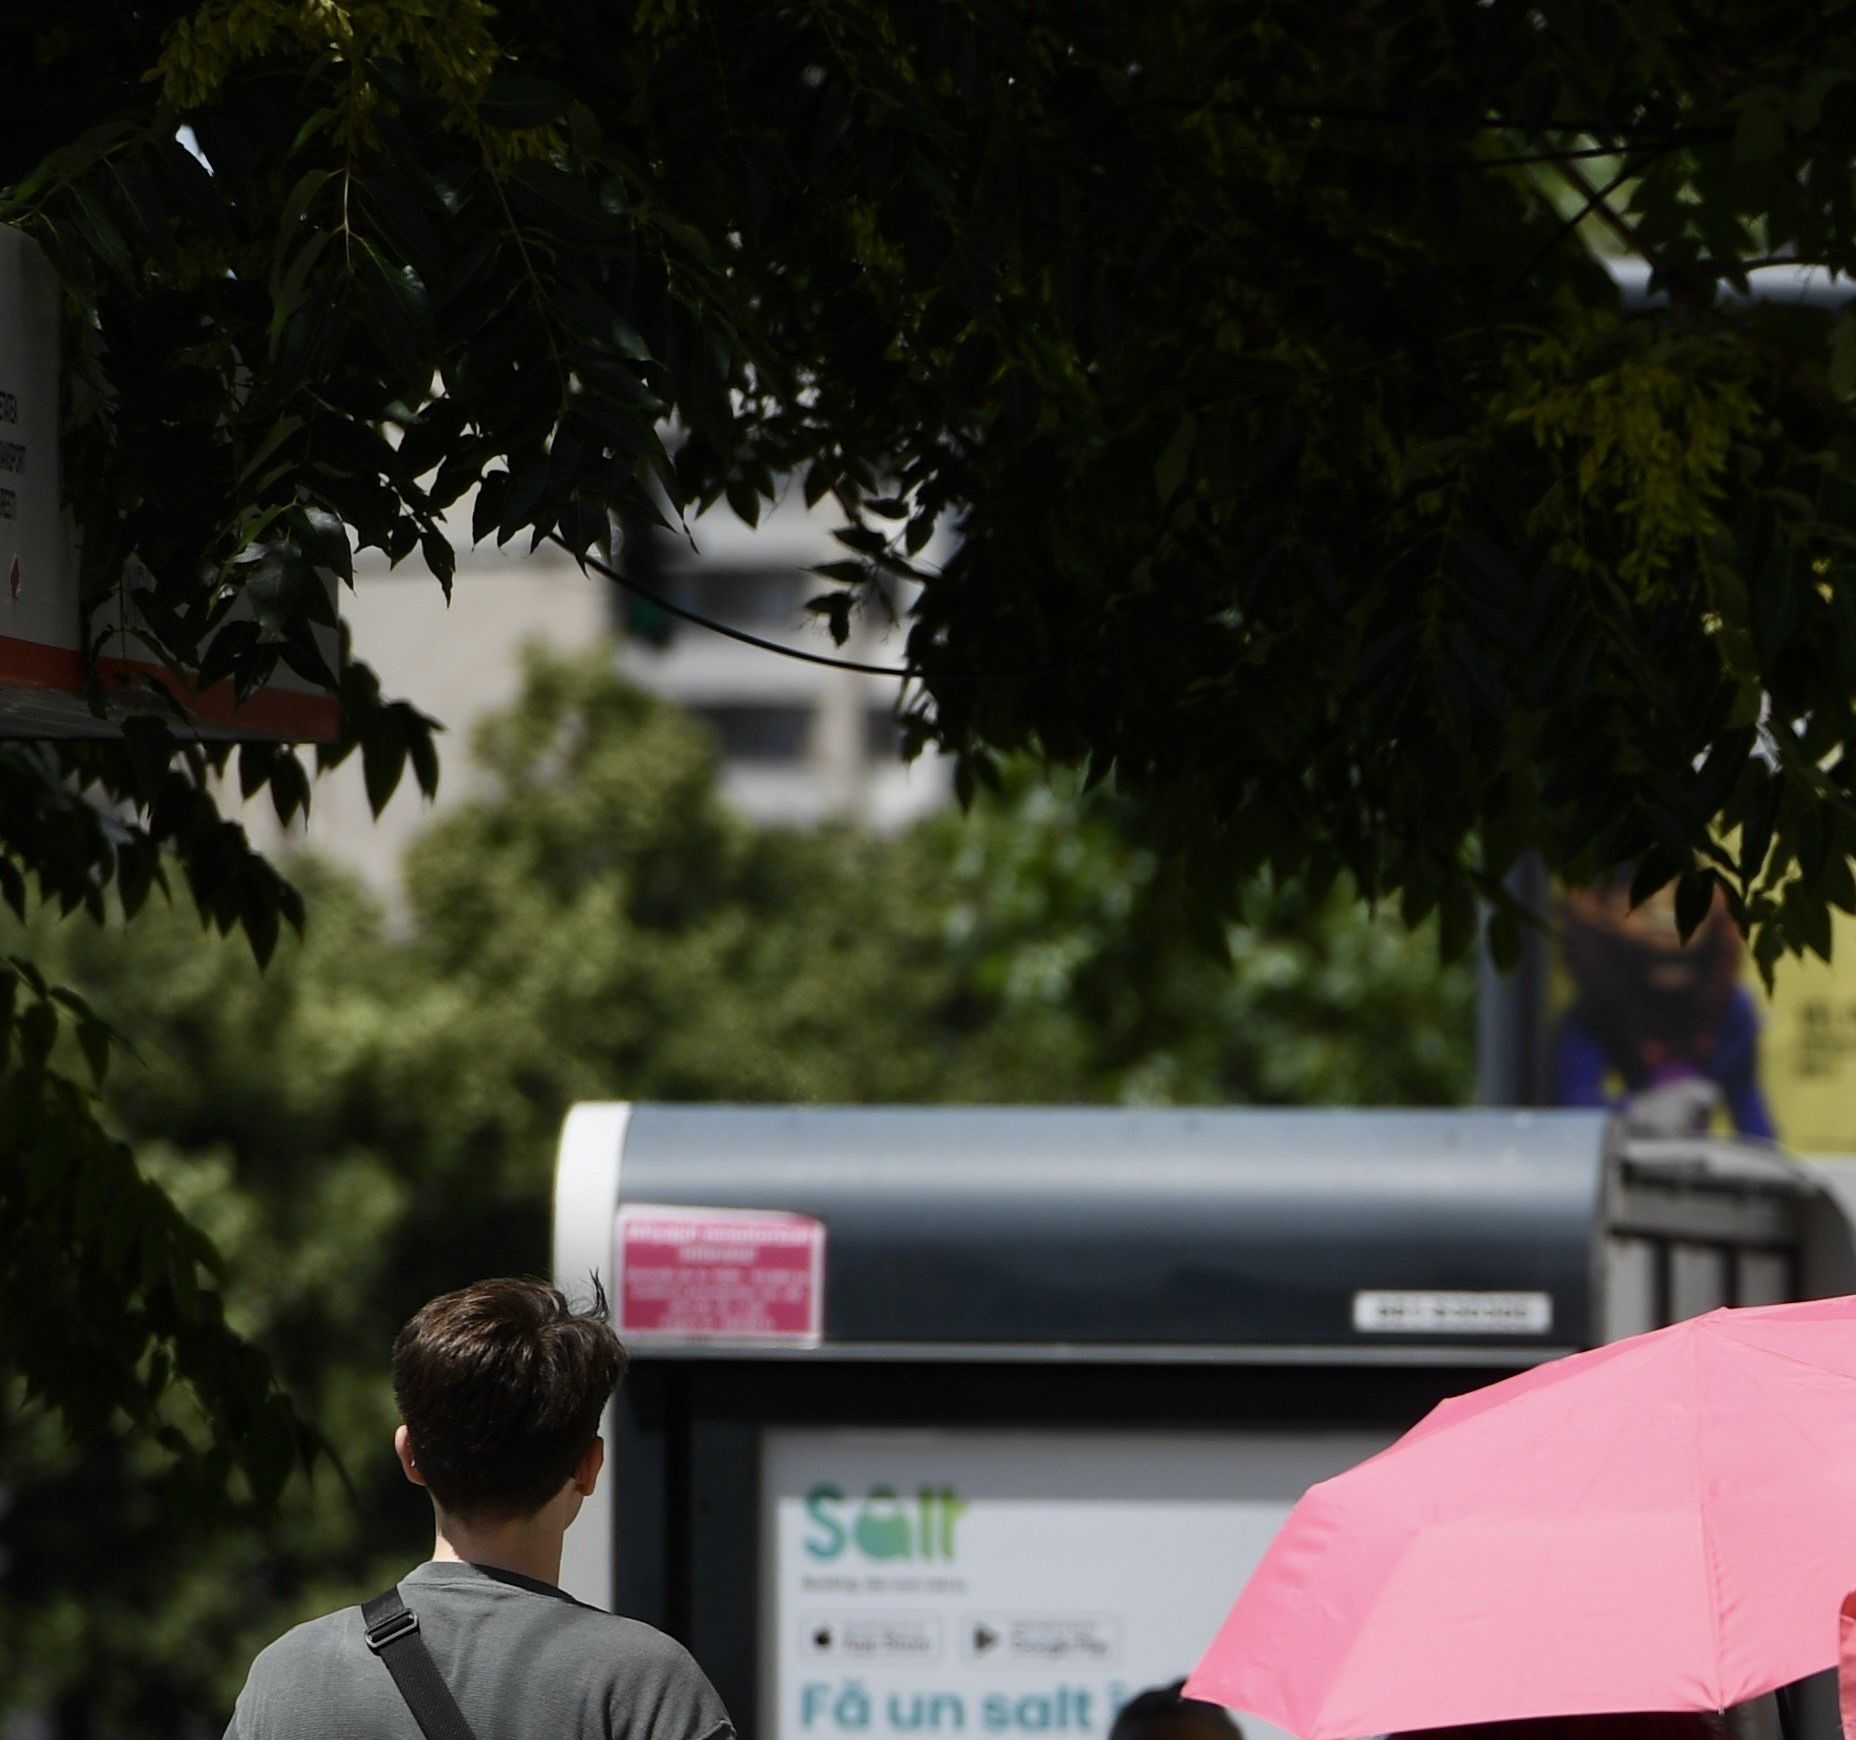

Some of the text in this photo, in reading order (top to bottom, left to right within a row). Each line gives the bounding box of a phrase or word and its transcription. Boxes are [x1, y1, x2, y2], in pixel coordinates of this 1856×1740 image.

[802, 1679, 870, 1732] Fă
[888, 1694, 965, 1732] un
[982, 1682, 1092, 1733] salt
